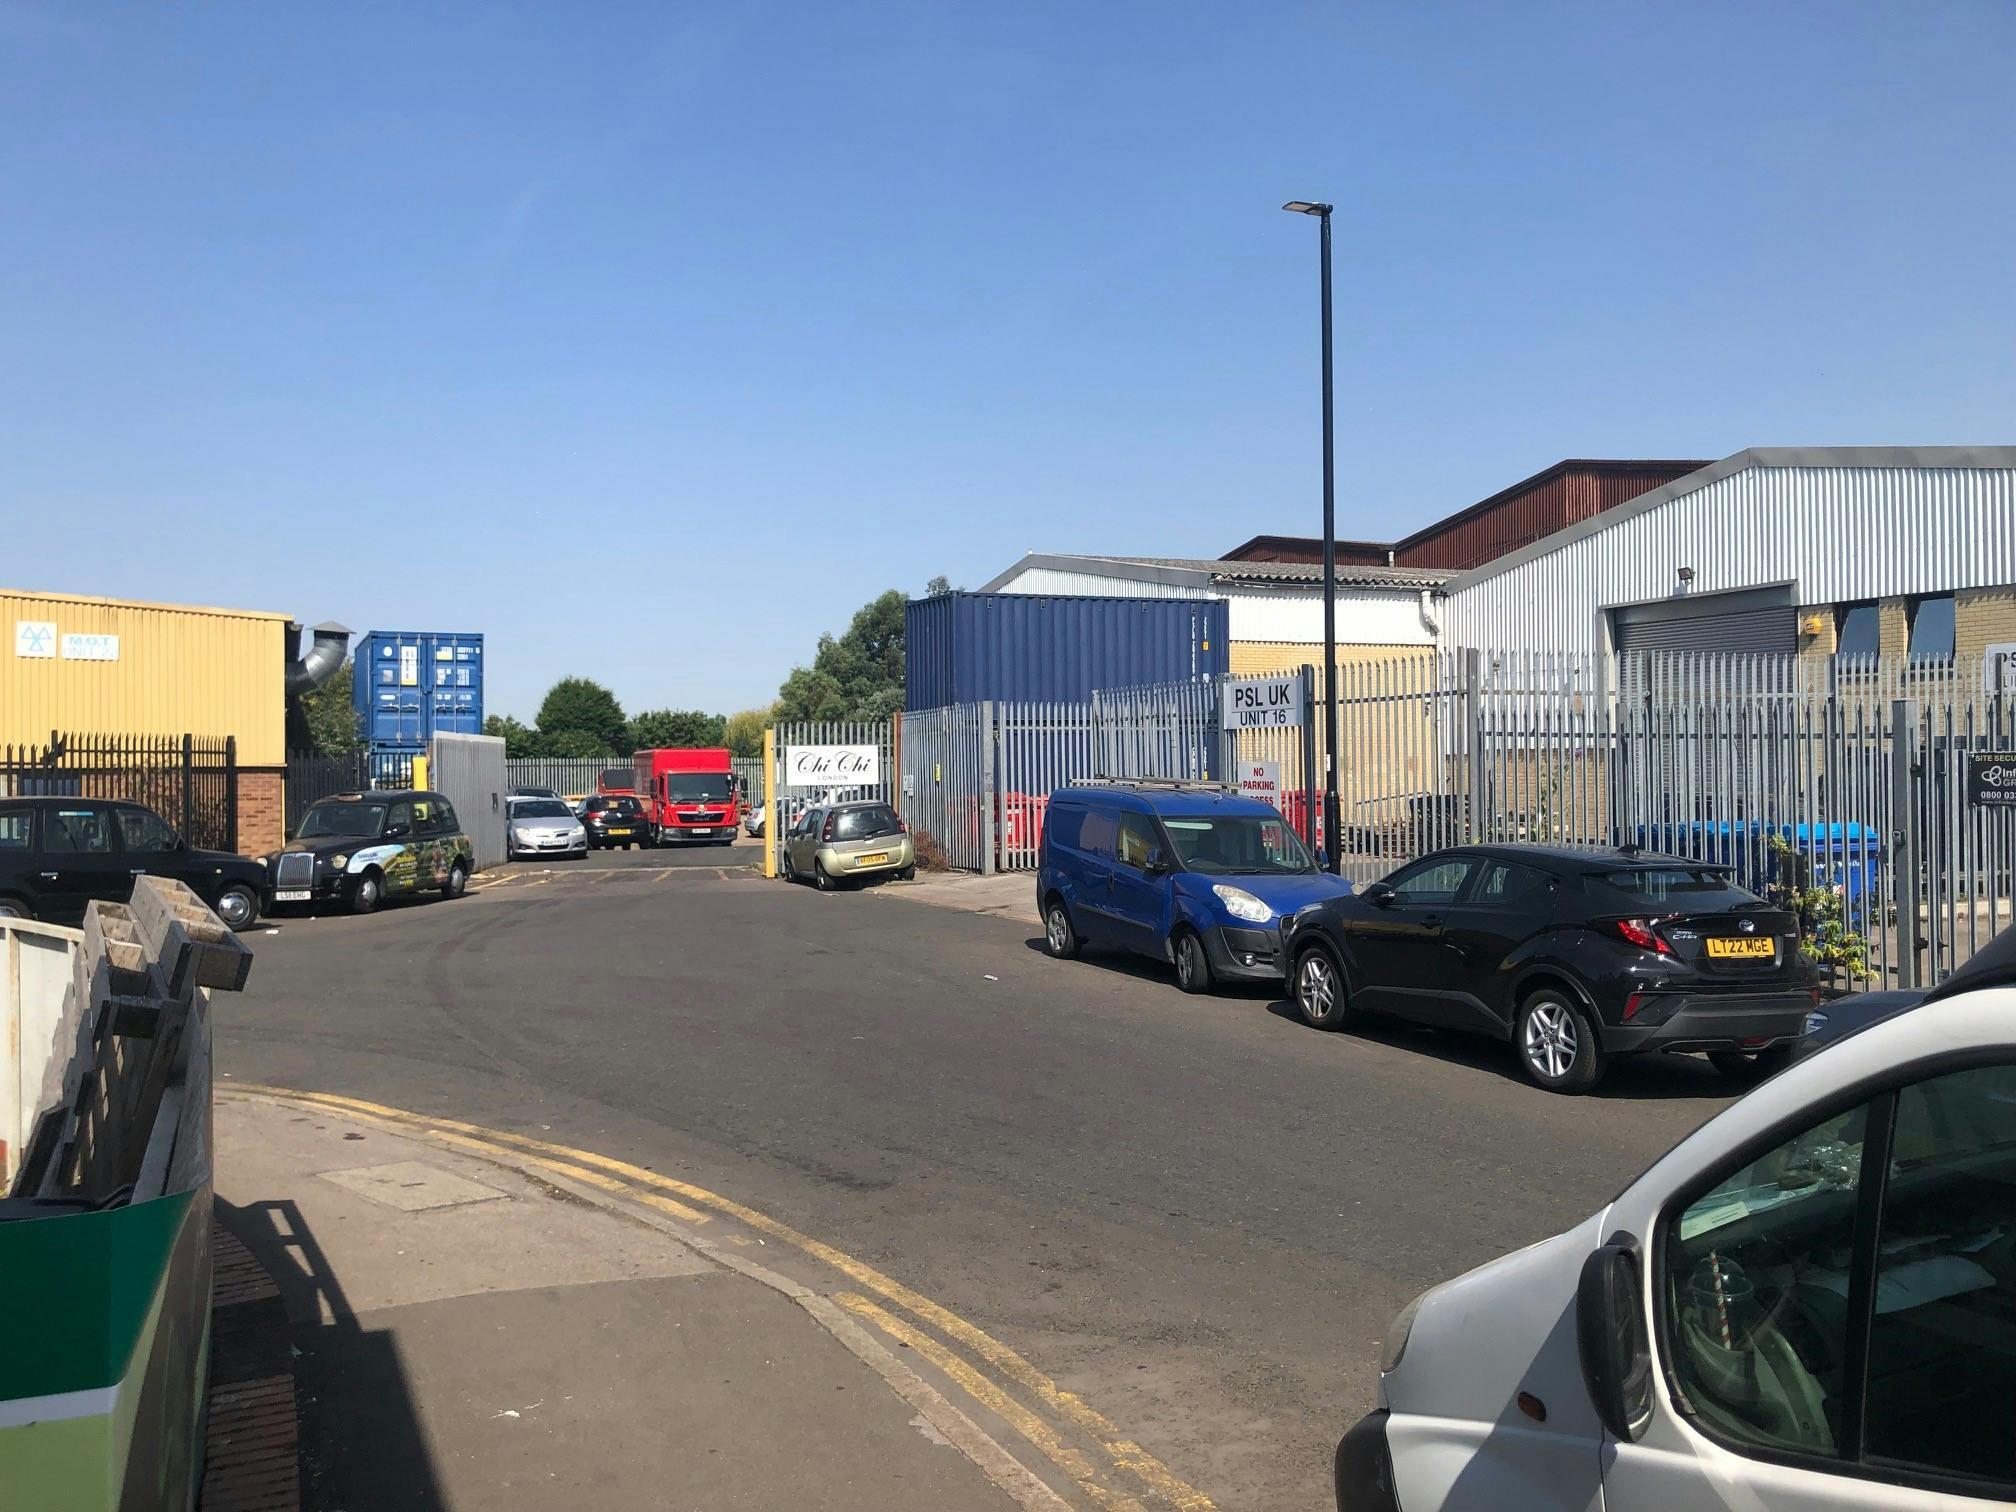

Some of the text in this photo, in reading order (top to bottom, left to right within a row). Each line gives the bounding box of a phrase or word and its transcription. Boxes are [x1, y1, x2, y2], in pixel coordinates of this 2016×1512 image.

[1235, 683, 1290, 708] PSL UK
[1240, 709, 1287, 727] UNIT 16
[794, 750, 871, 774] Chi Chi
[1975, 754, 1993, 762] SITE
[1253, 767, 1264, 777] NO
[1243, 780, 1275, 791] PARKING
[1980, 791, 2002, 799] 0800
[1712, 938, 1769, 953] LT22 MGE
